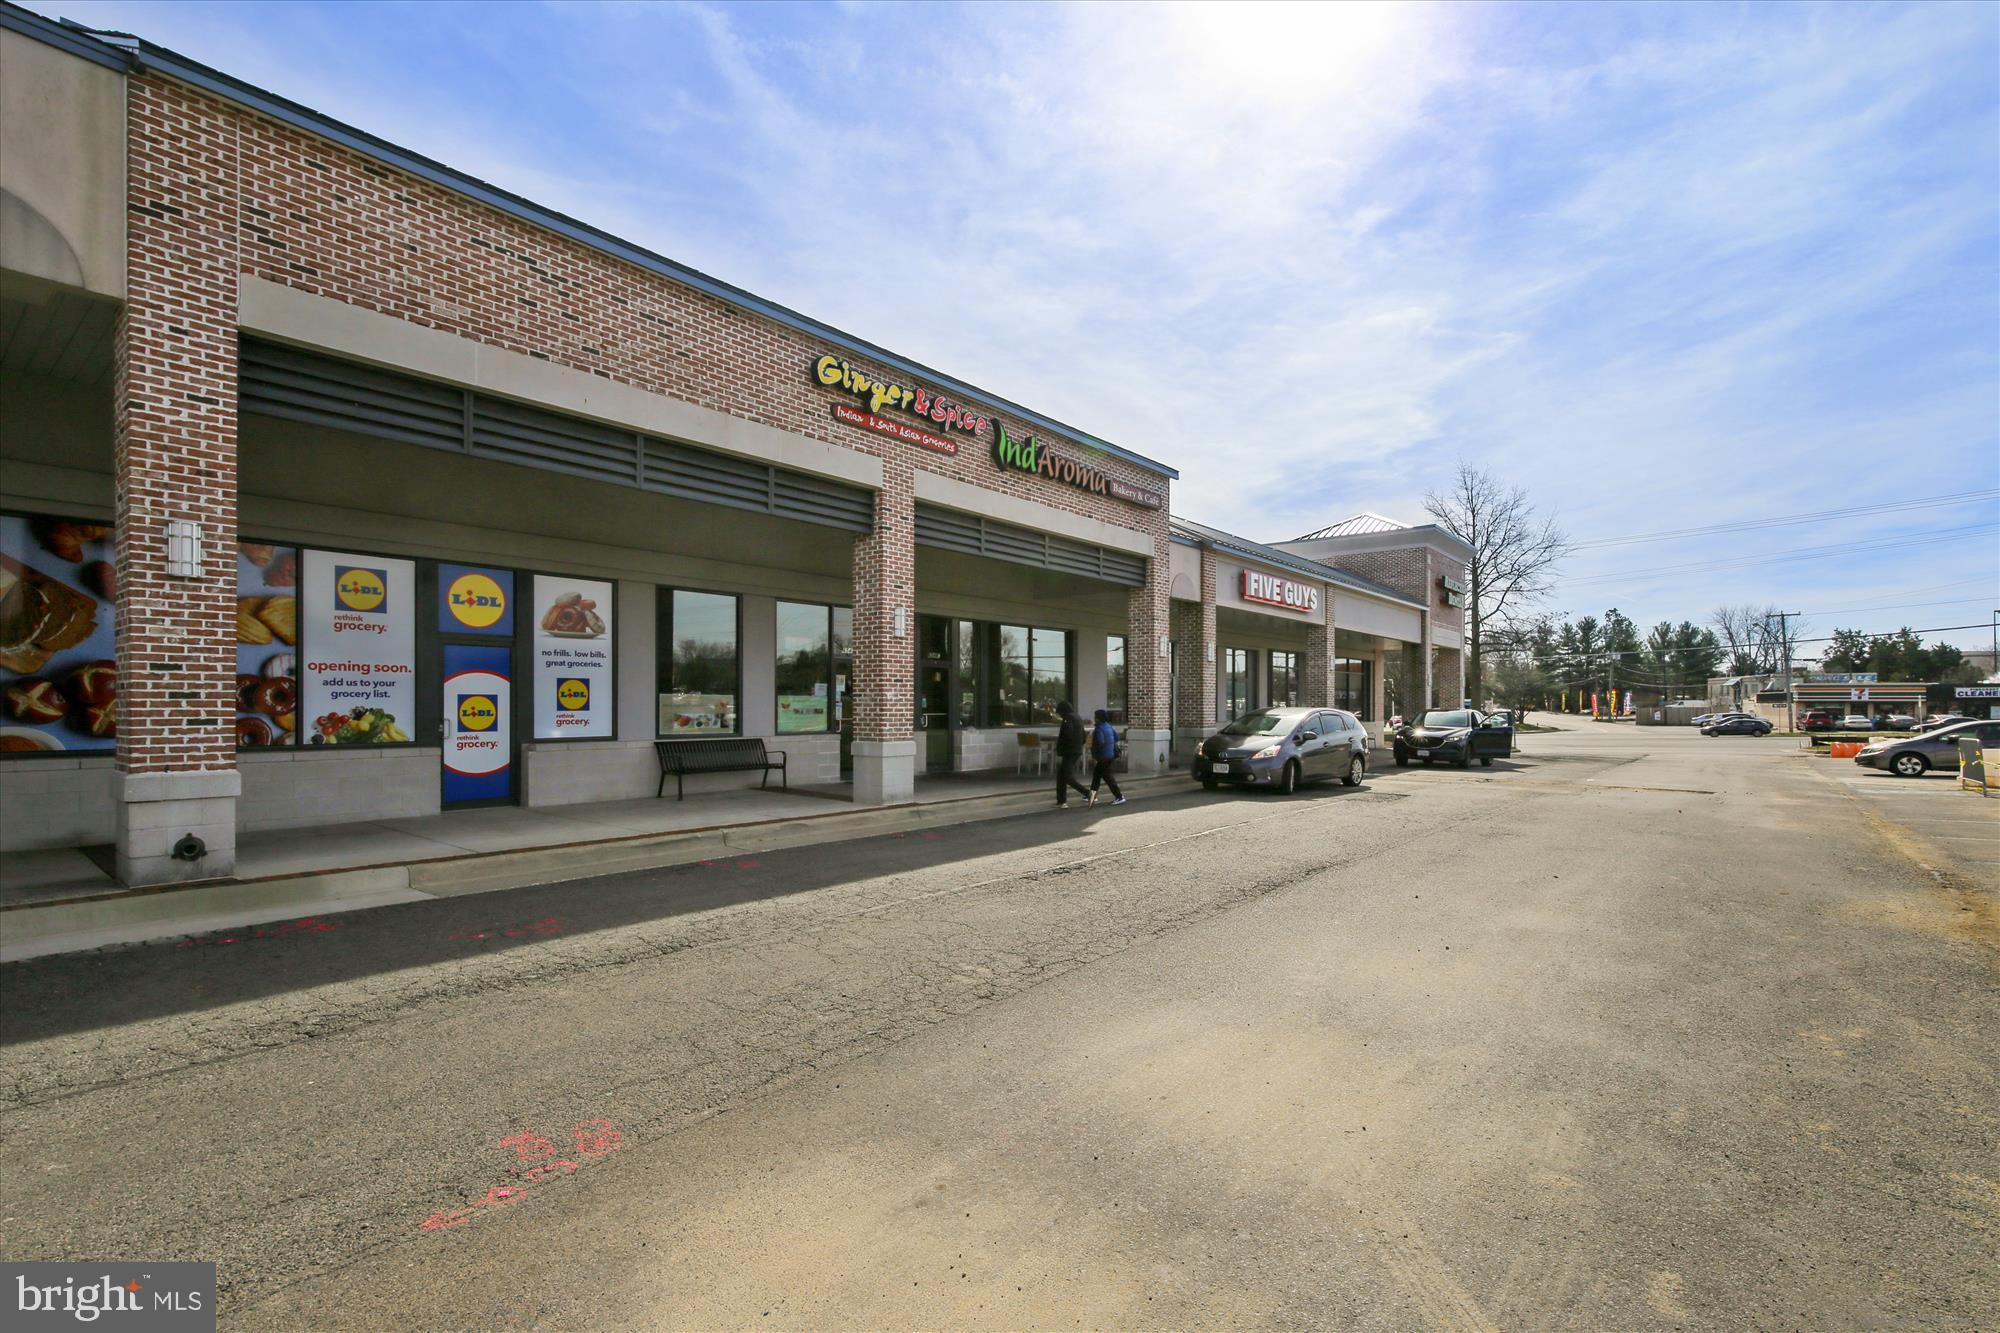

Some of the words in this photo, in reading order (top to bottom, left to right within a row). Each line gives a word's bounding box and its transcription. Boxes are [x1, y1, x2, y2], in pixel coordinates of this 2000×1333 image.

[817, 355, 914, 413] Ginger
[914, 388, 930, 416] &
[931, 396, 987, 436] Spice
[837, 405, 864, 422] Indian
[870, 417, 875, 426] &
[876, 420, 897, 433] South
[899, 427, 921, 440] Asian
[922, 435, 955, 452] Groceries
[1113, 483, 1136, 501] Bakery
[1138, 492, 1143, 501] &
[1250, 572, 1280, 601] FIVE
[1285, 582, 1318, 610] GUYS
[335, 614, 363, 622] rethink
[334, 622, 388, 634] grocery.
[554, 649, 572, 657] frills.
[574, 650, 588, 658] low
[307, 660, 371, 675] opening
[374, 664, 412, 673] soon.
[546, 660, 566, 668] great
[322, 678, 344, 687] add
[372, 681, 397, 689] your
[331, 691, 371, 700] grocery
[373, 690, 391, 698] list.
[457, 741, 498, 751] grocery.
